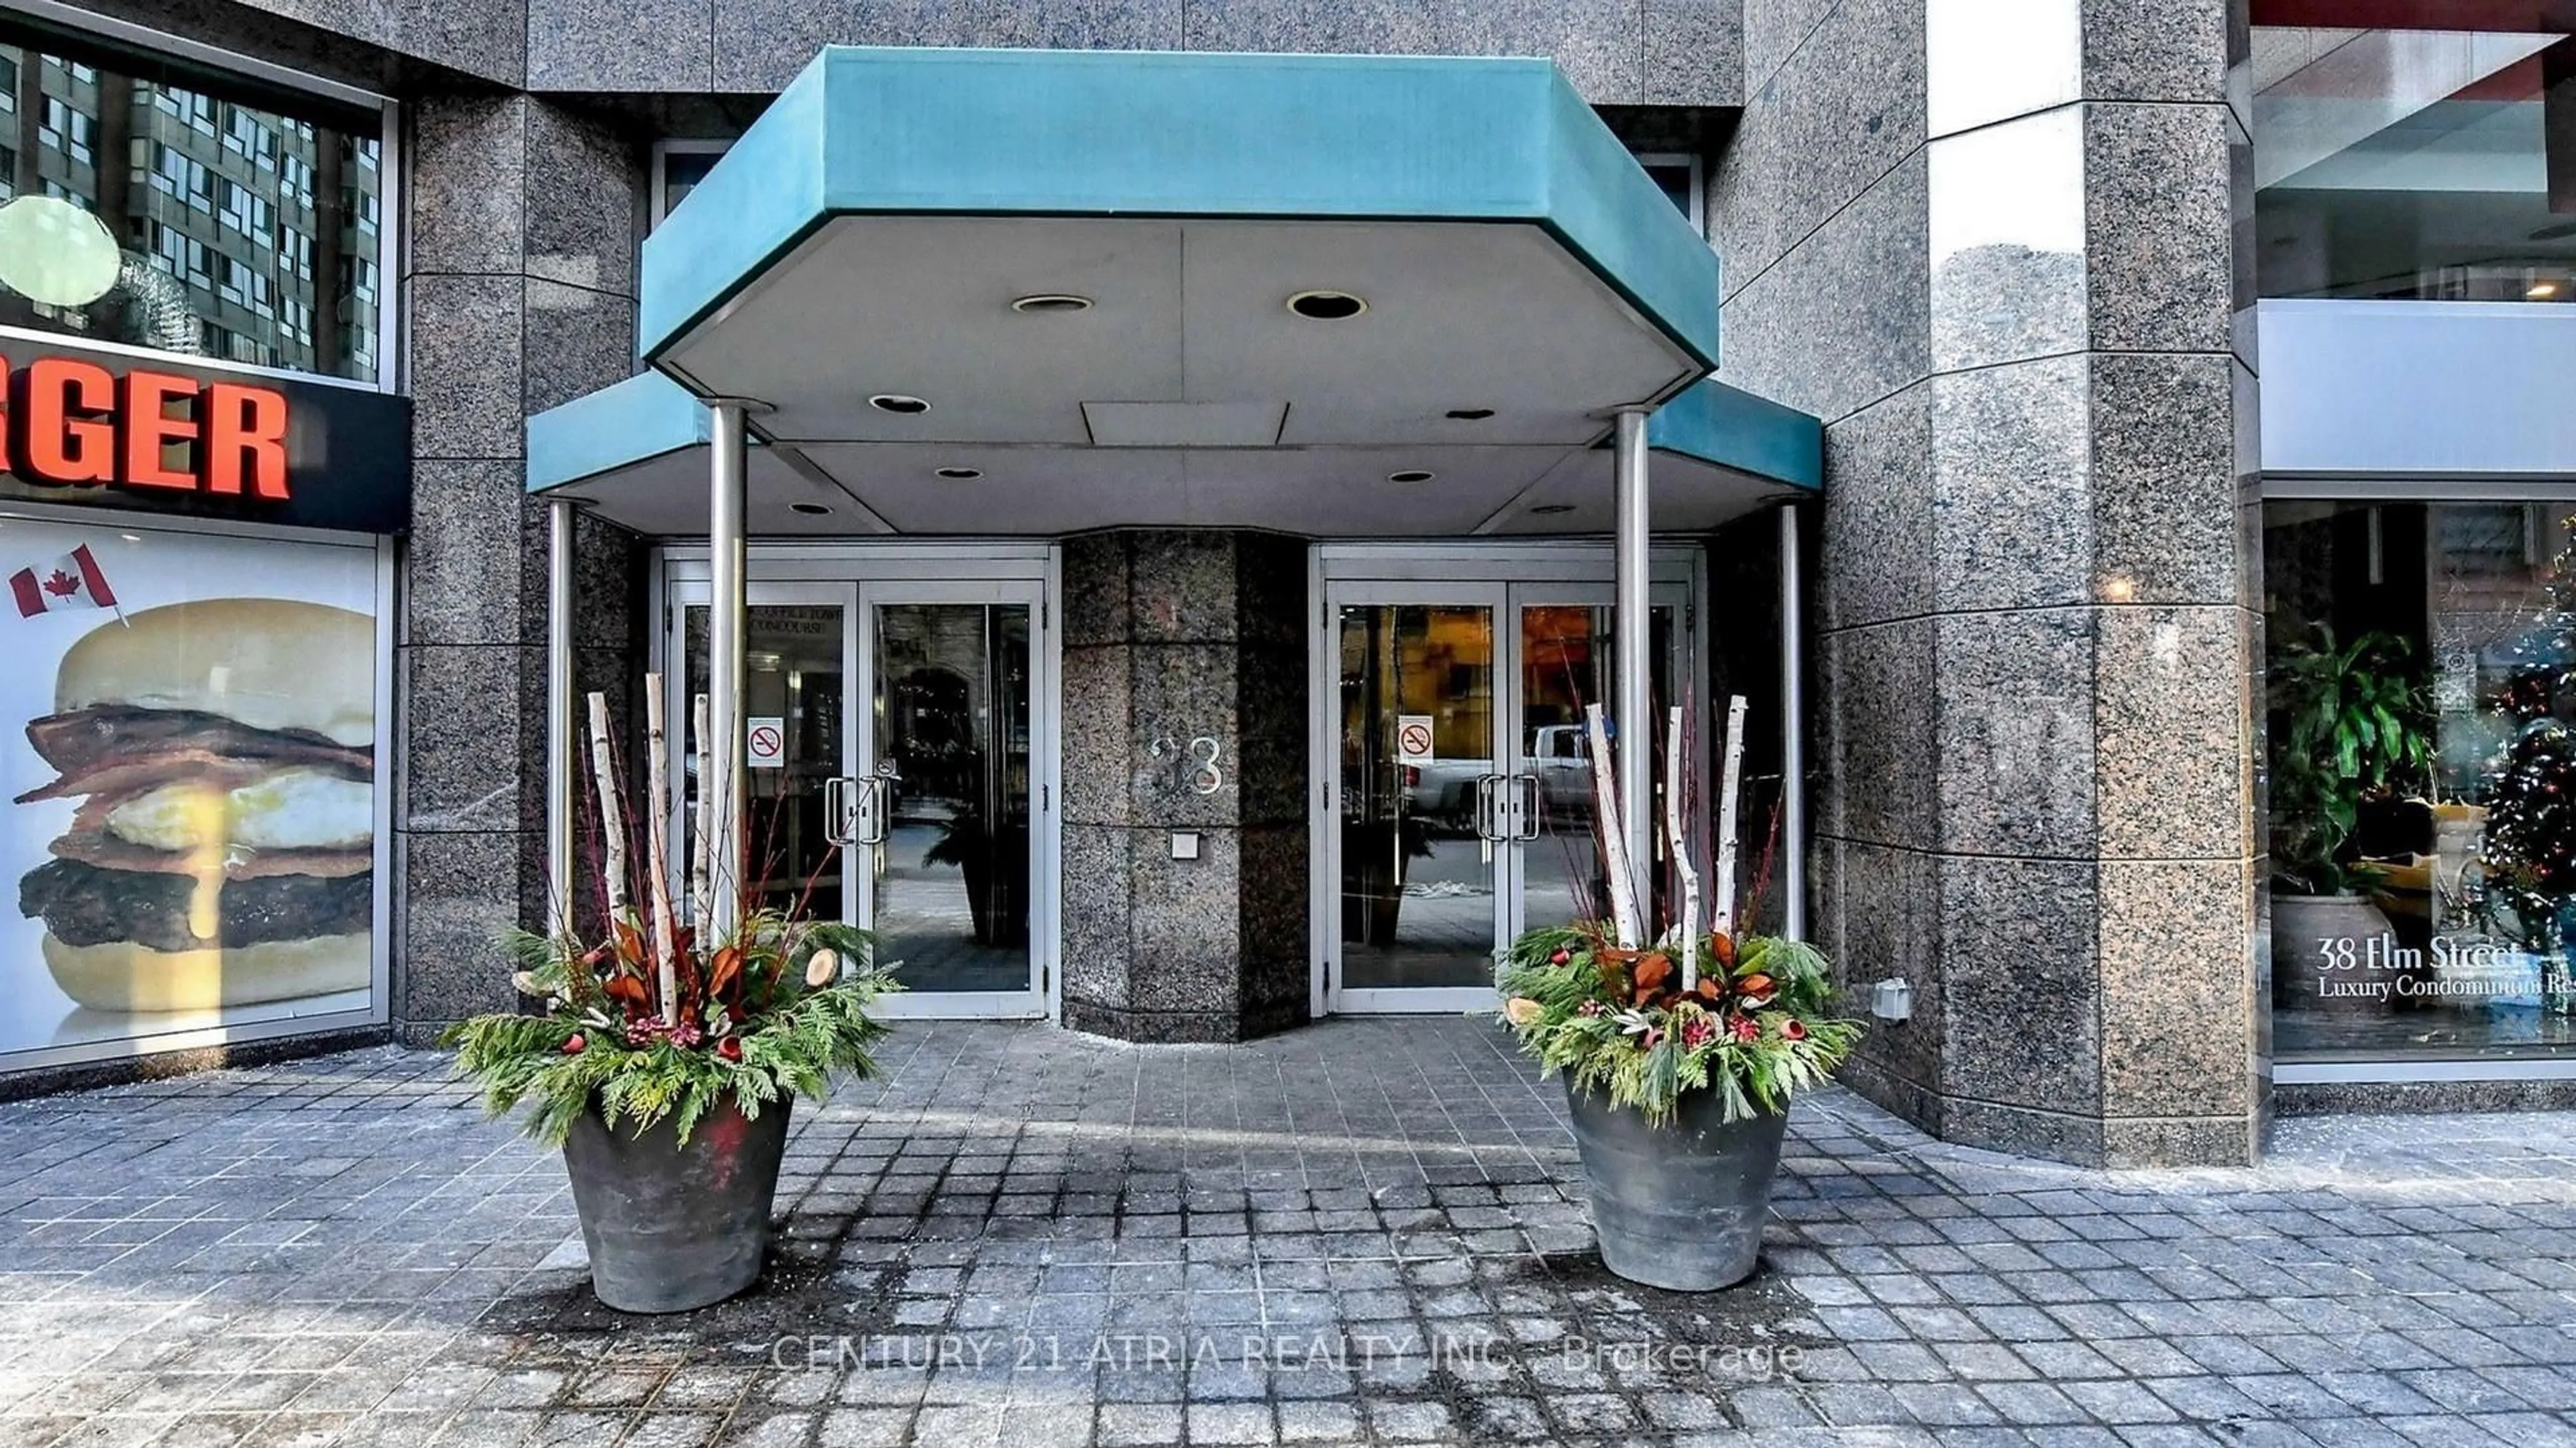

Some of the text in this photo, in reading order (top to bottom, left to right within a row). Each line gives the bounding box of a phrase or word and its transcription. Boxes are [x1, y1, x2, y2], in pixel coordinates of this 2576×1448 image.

[0, 354, 290, 499] GER
[2316, 932, 2524, 971] 38 Elm Street
[2318, 976, 2392, 1002] Luxury
[2396, 974, 2542, 997] Condominium
